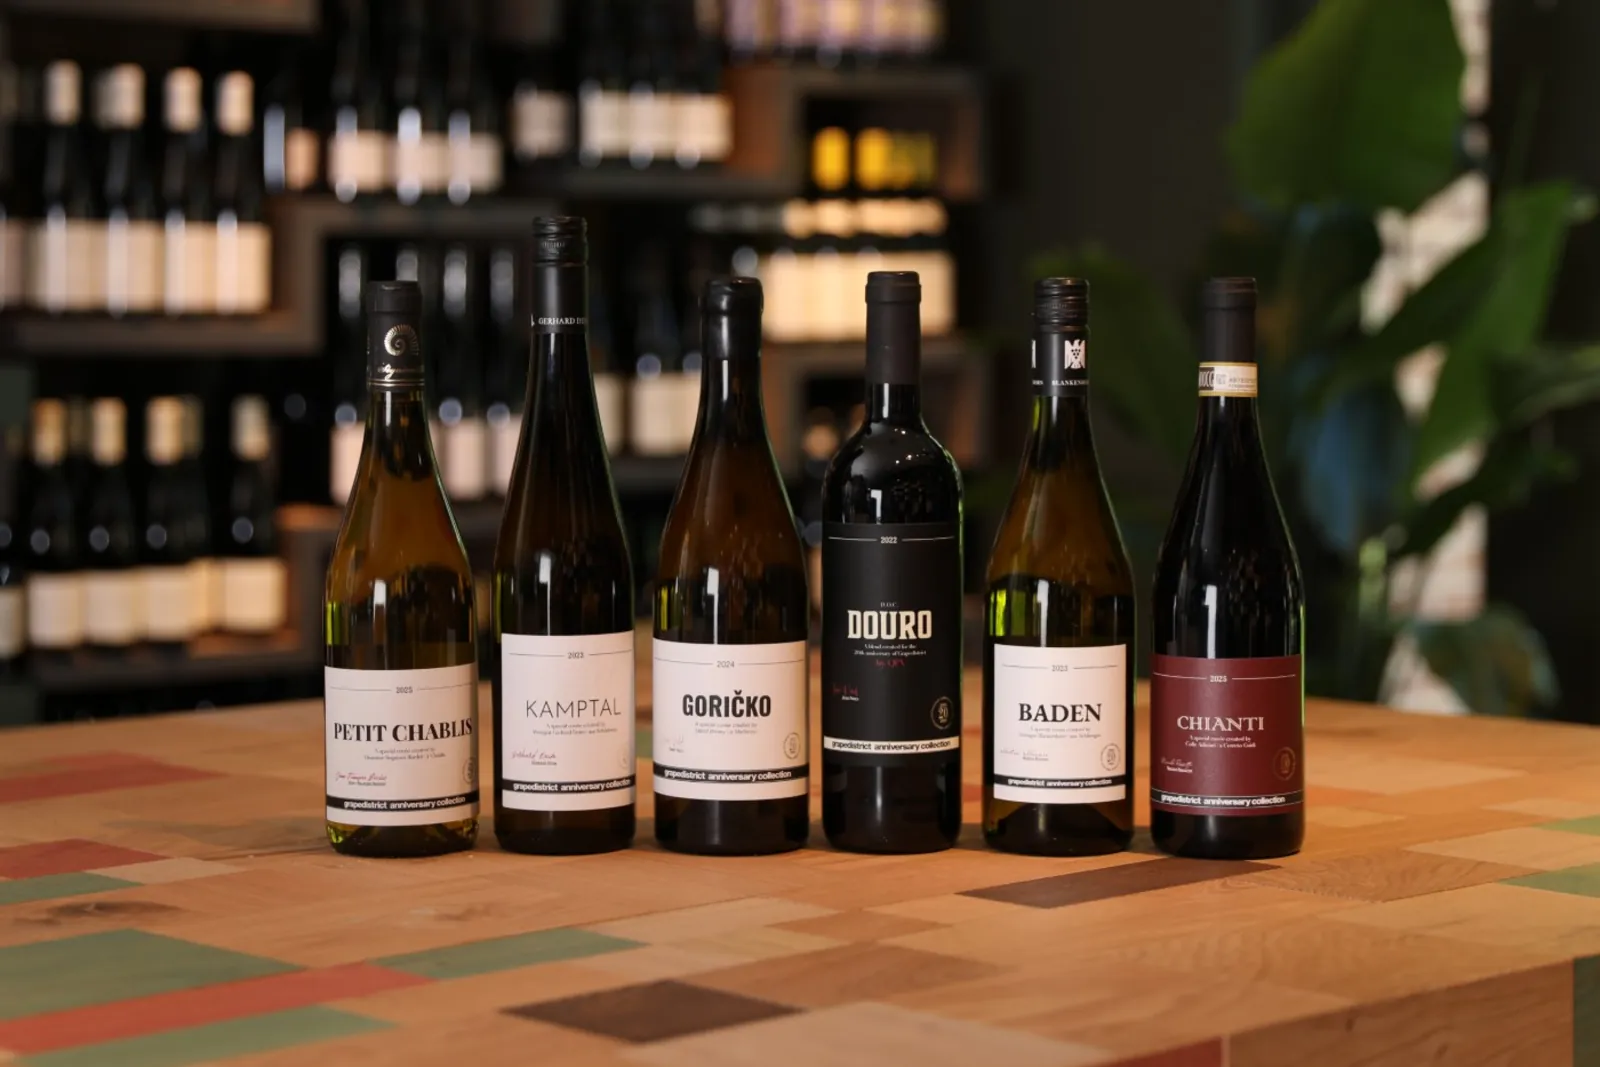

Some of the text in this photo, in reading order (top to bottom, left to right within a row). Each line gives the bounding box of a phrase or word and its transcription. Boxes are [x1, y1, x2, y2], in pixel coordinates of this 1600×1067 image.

[848, 610, 932, 640] DOURO
[526, 698, 622, 718] KAMPTAL
[682, 690, 771, 717] GORIČKO
[1018, 702, 1102, 722] BADEN
[334, 718, 472, 742] PETIT CHABLIS
[1177, 715, 1264, 731] CHIANTI
[832, 740, 951, 752] grapedistrict anniversary collection
[664, 769, 792, 782] grapedistrict anniversary collection
[1046, 779, 1084, 788] anniversary
[1085, 778, 1112, 787] collection
[513, 778, 630, 792] grapedistrict anniversary collection
[344, 796, 466, 810] grapedistrict anniversary collection
[1204, 798, 1250, 807] anniversary
[1251, 796, 1285, 805] collection
